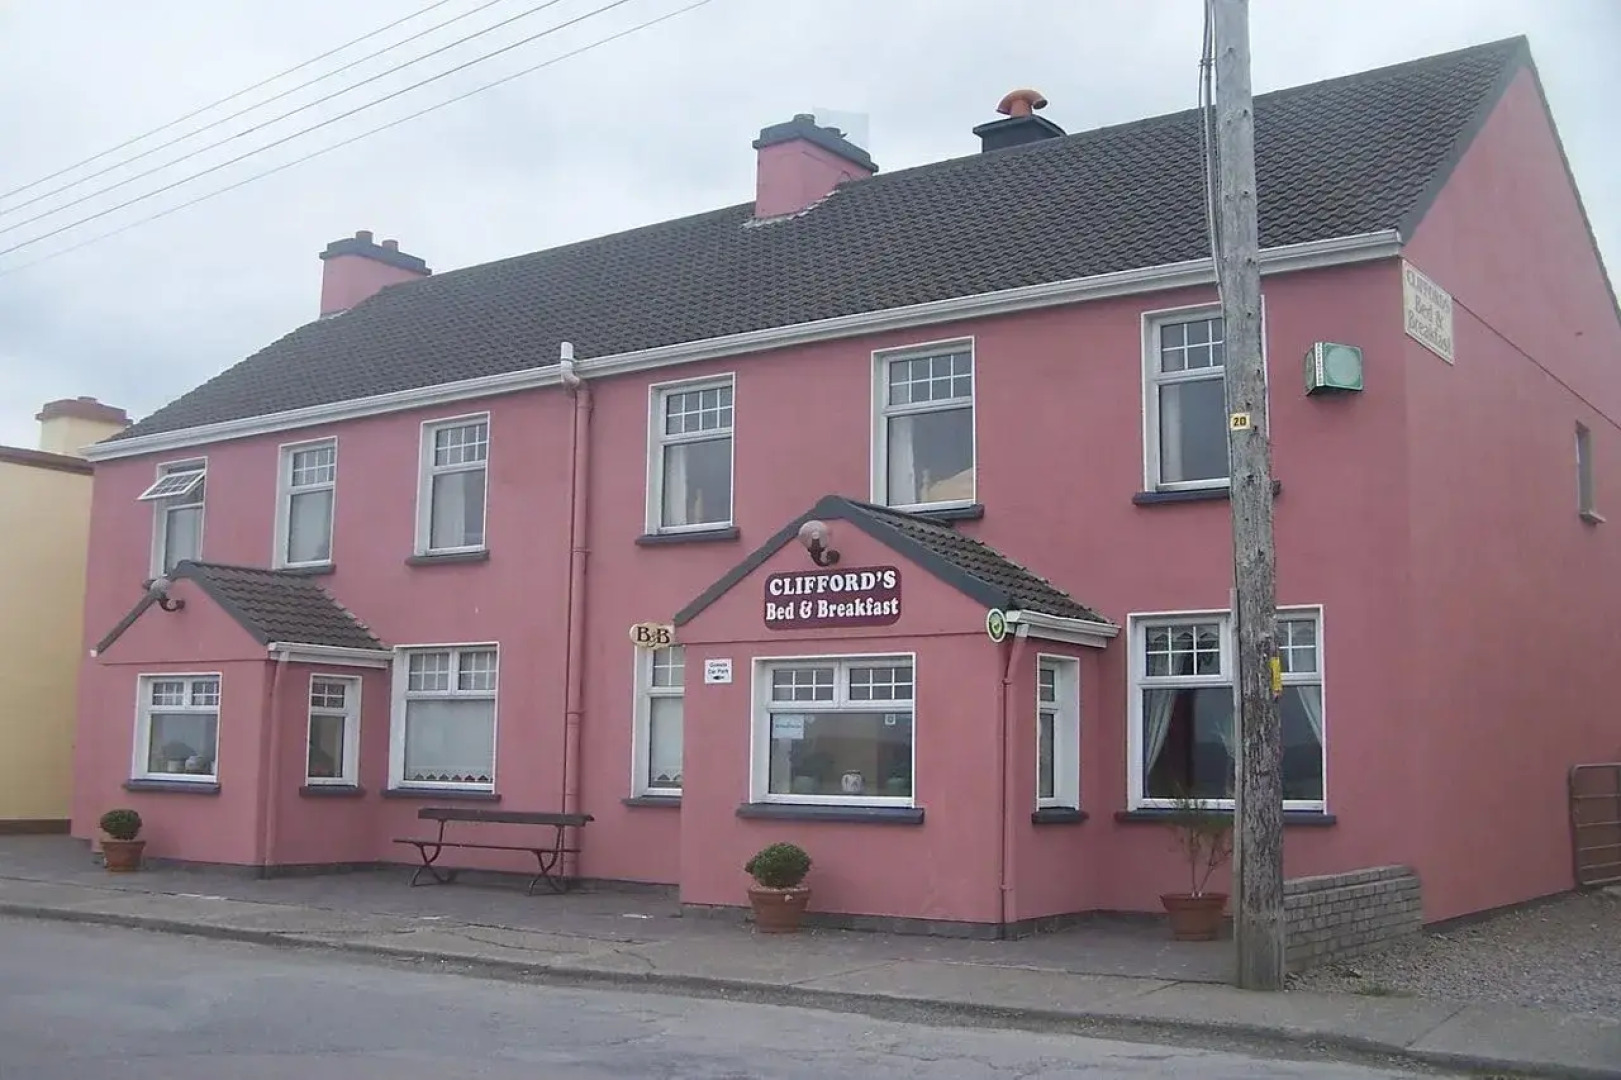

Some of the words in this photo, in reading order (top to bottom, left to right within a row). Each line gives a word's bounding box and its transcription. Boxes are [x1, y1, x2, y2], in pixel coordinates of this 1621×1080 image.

[1233, 416, 1246, 427] 20
[769, 570, 896, 596] CLIFFORD'S
[766, 602, 794, 620] Bed
[800, 600, 812, 619] &
[817, 597, 899, 618] Breakfast
[637, 626, 670, 647] B&B
